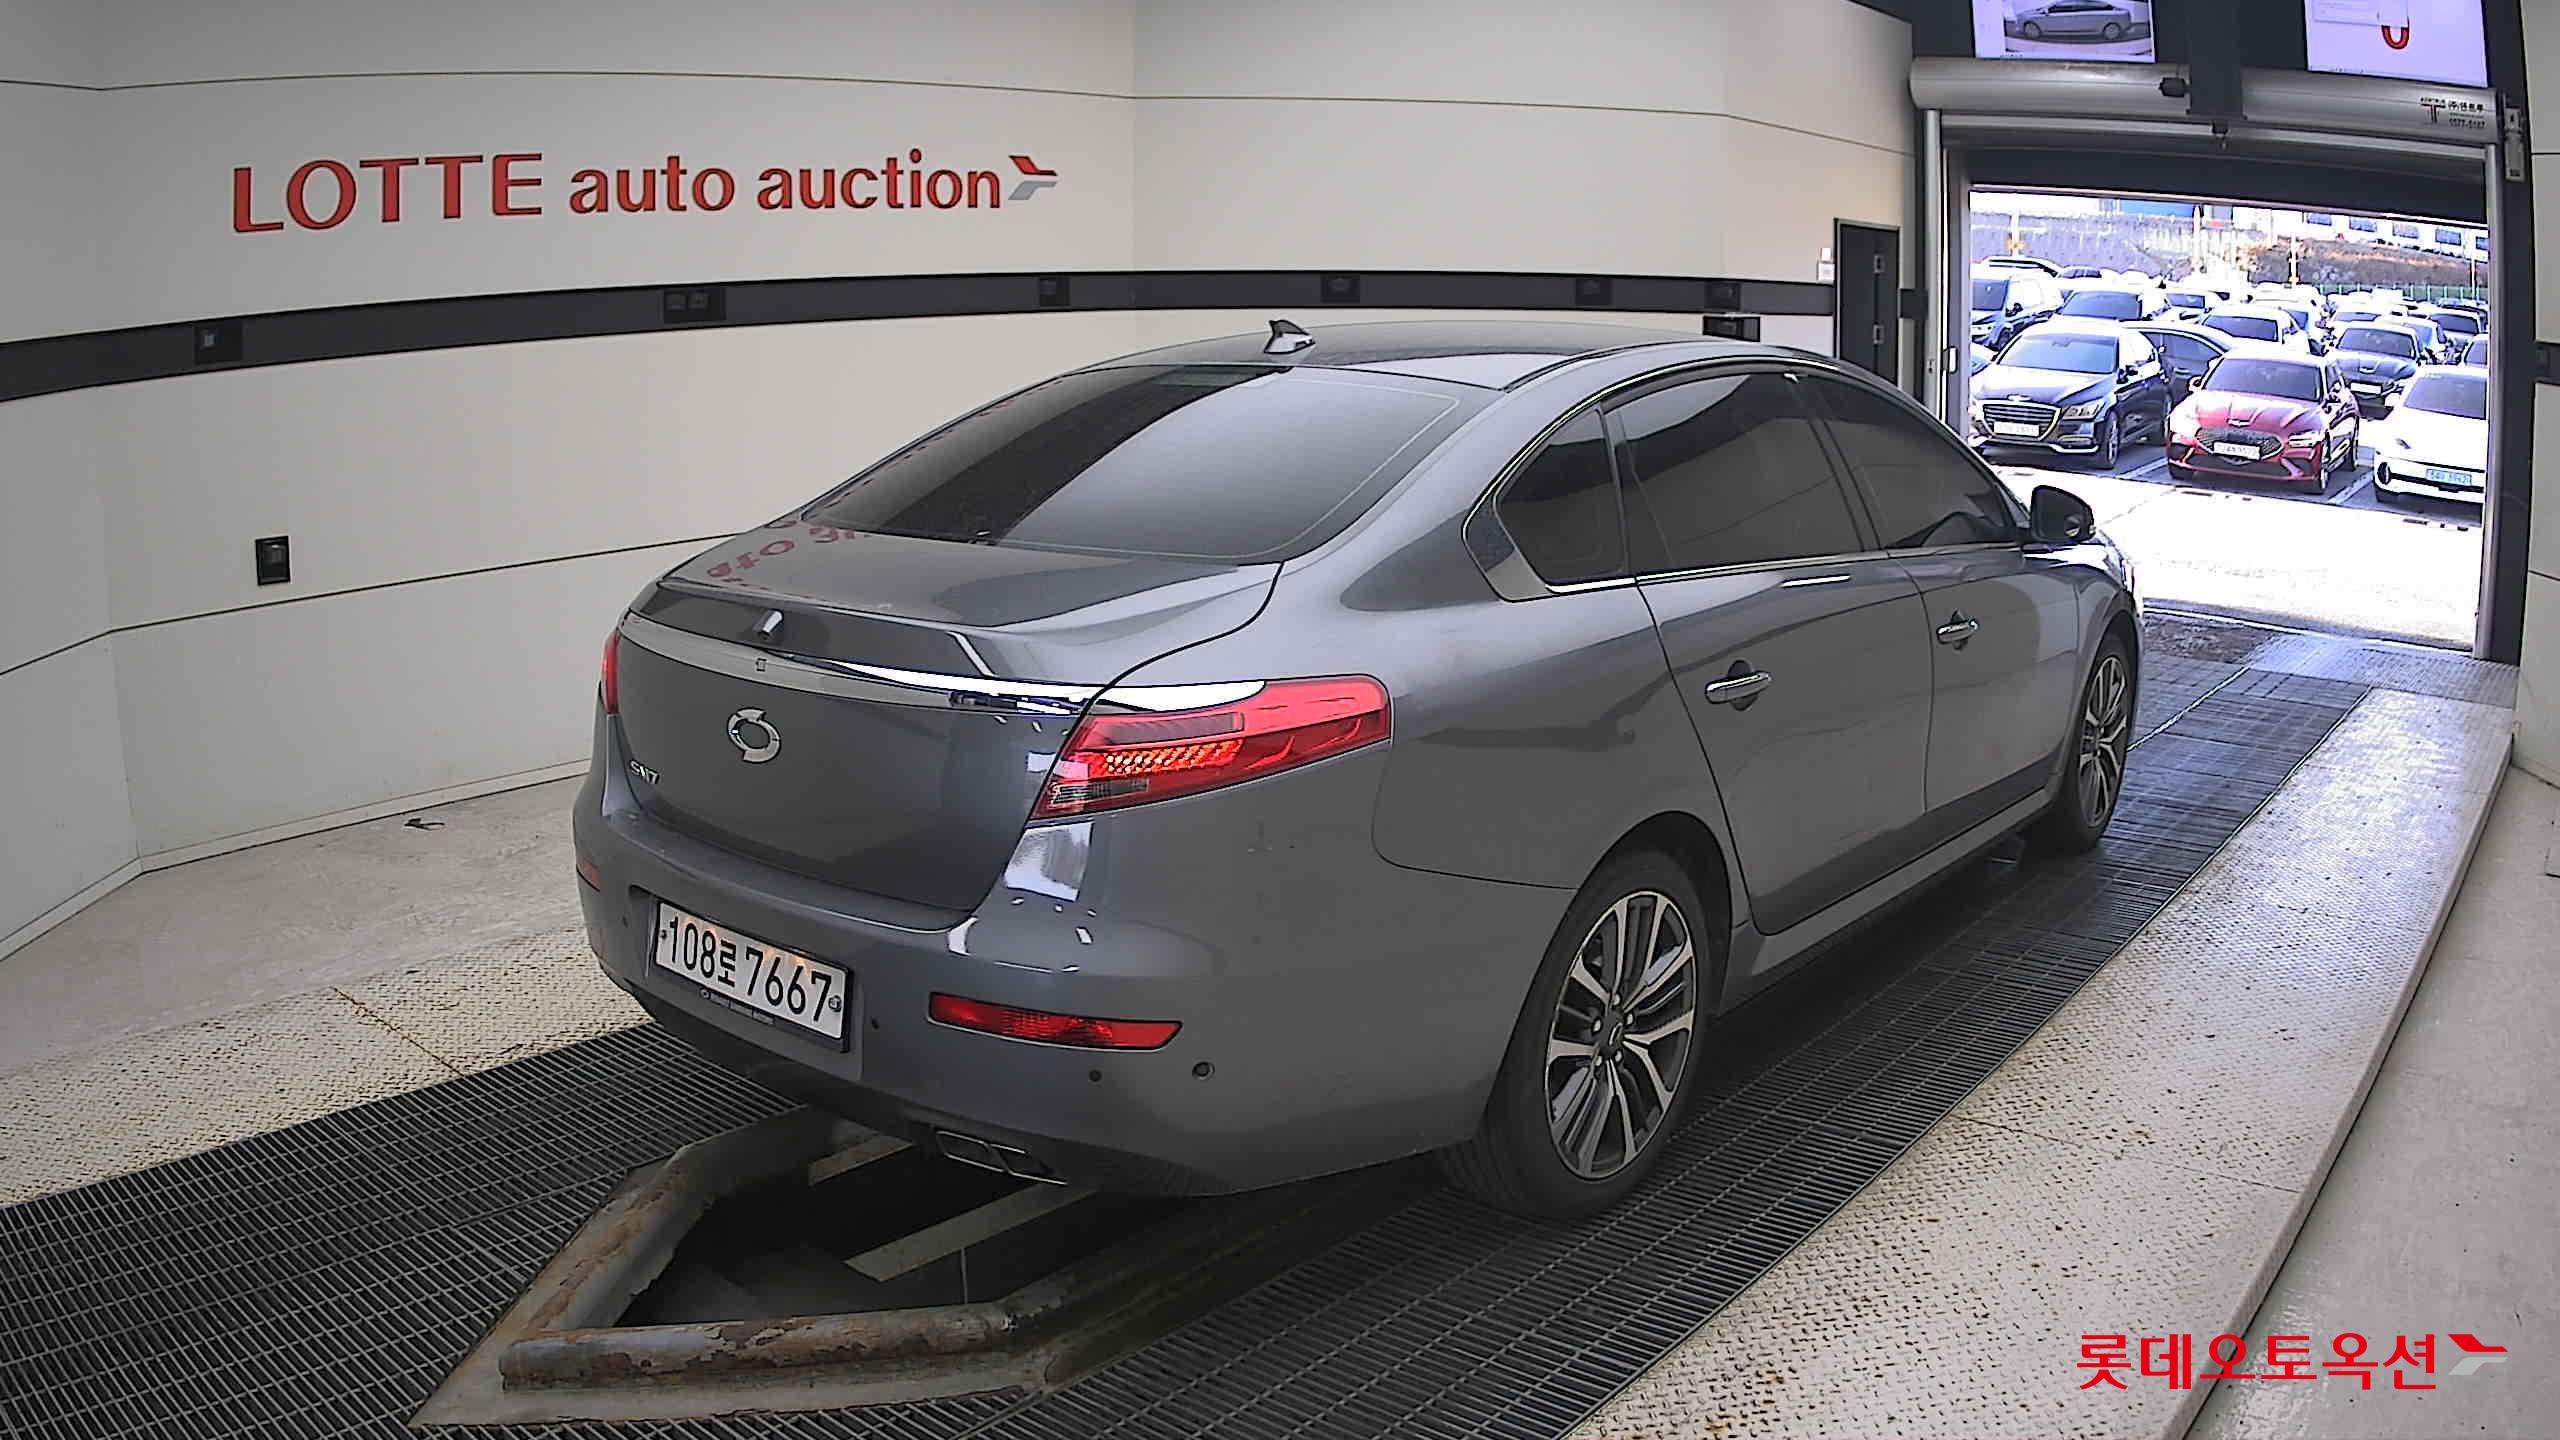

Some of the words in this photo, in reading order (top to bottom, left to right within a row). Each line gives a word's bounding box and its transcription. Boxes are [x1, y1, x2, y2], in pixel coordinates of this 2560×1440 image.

[233, 153, 542, 233] LOTTE
[568, 155, 736, 214] auto
[756, 148, 1002, 211] auction
[745, 946, 832, 1022] 7667
